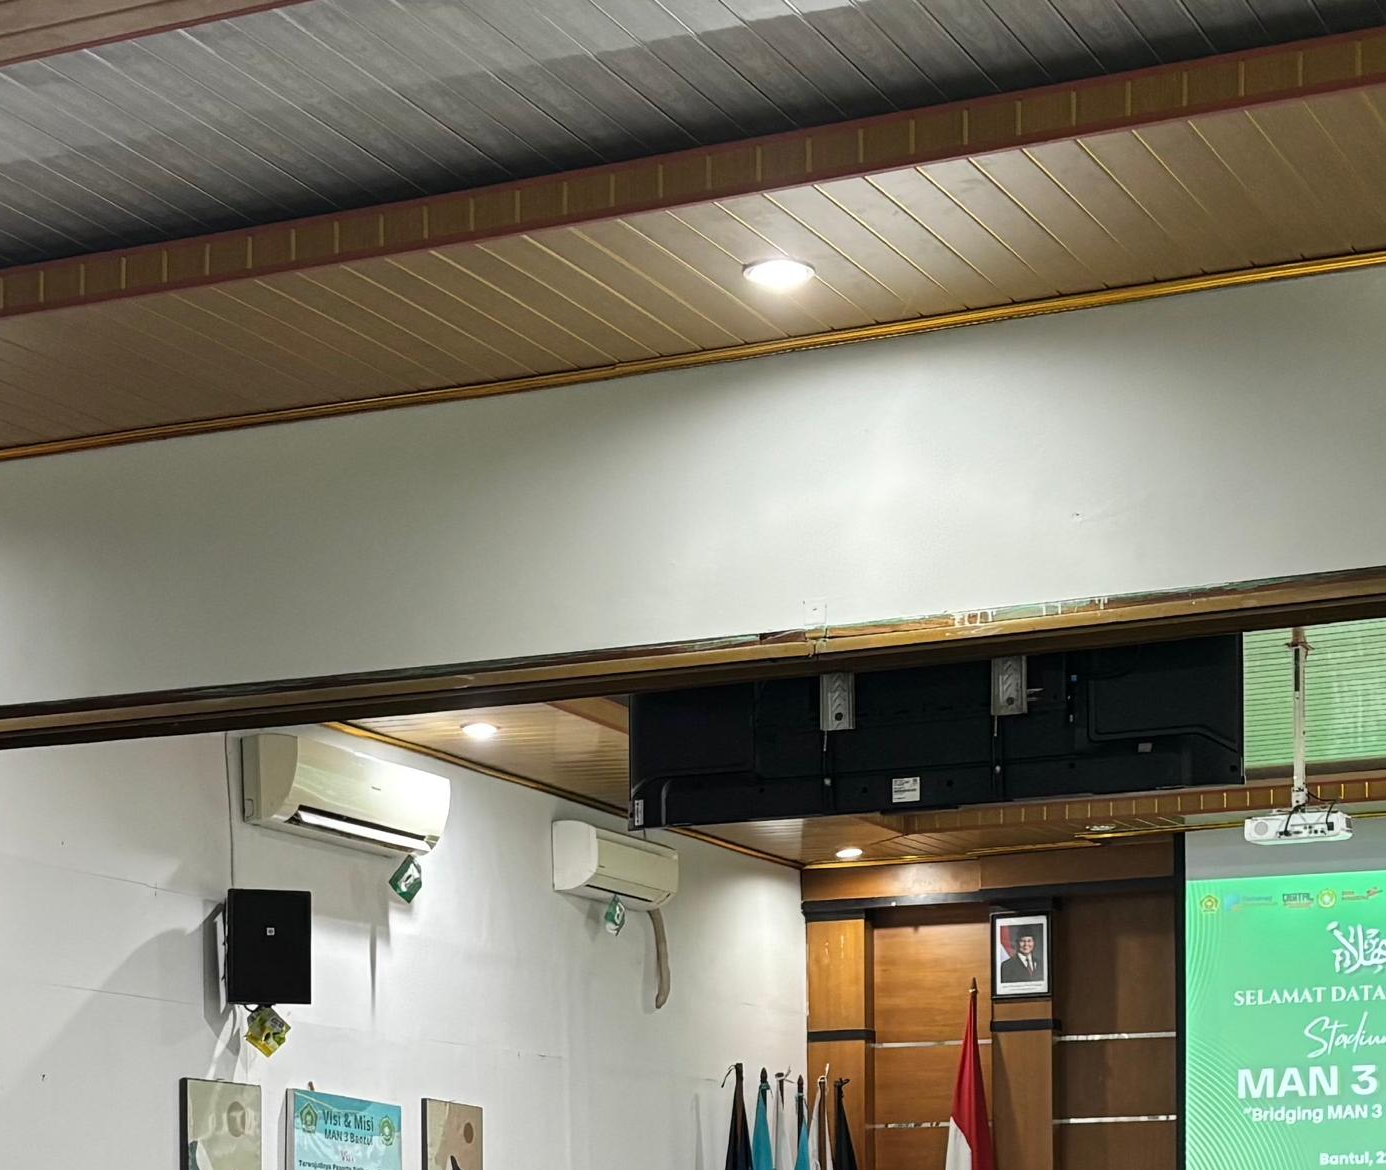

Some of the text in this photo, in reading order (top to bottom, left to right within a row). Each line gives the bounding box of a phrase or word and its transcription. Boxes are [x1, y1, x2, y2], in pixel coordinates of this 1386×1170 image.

[1233, 986, 1327, 1007] SELAMAT
[1237, 1065, 1340, 1100] MAN
[1350, 1063, 1378, 1097] 3
[1327, 1104, 1369, 1121] MAN
[1371, 1103, 1383, 1119] 3
[343, 1112, 352, 1128] &
[354, 1114, 374, 1132] Misi
[324, 1129, 343, 1142] MAN
[1319, 1151, 1373, 1167] Bantul,
